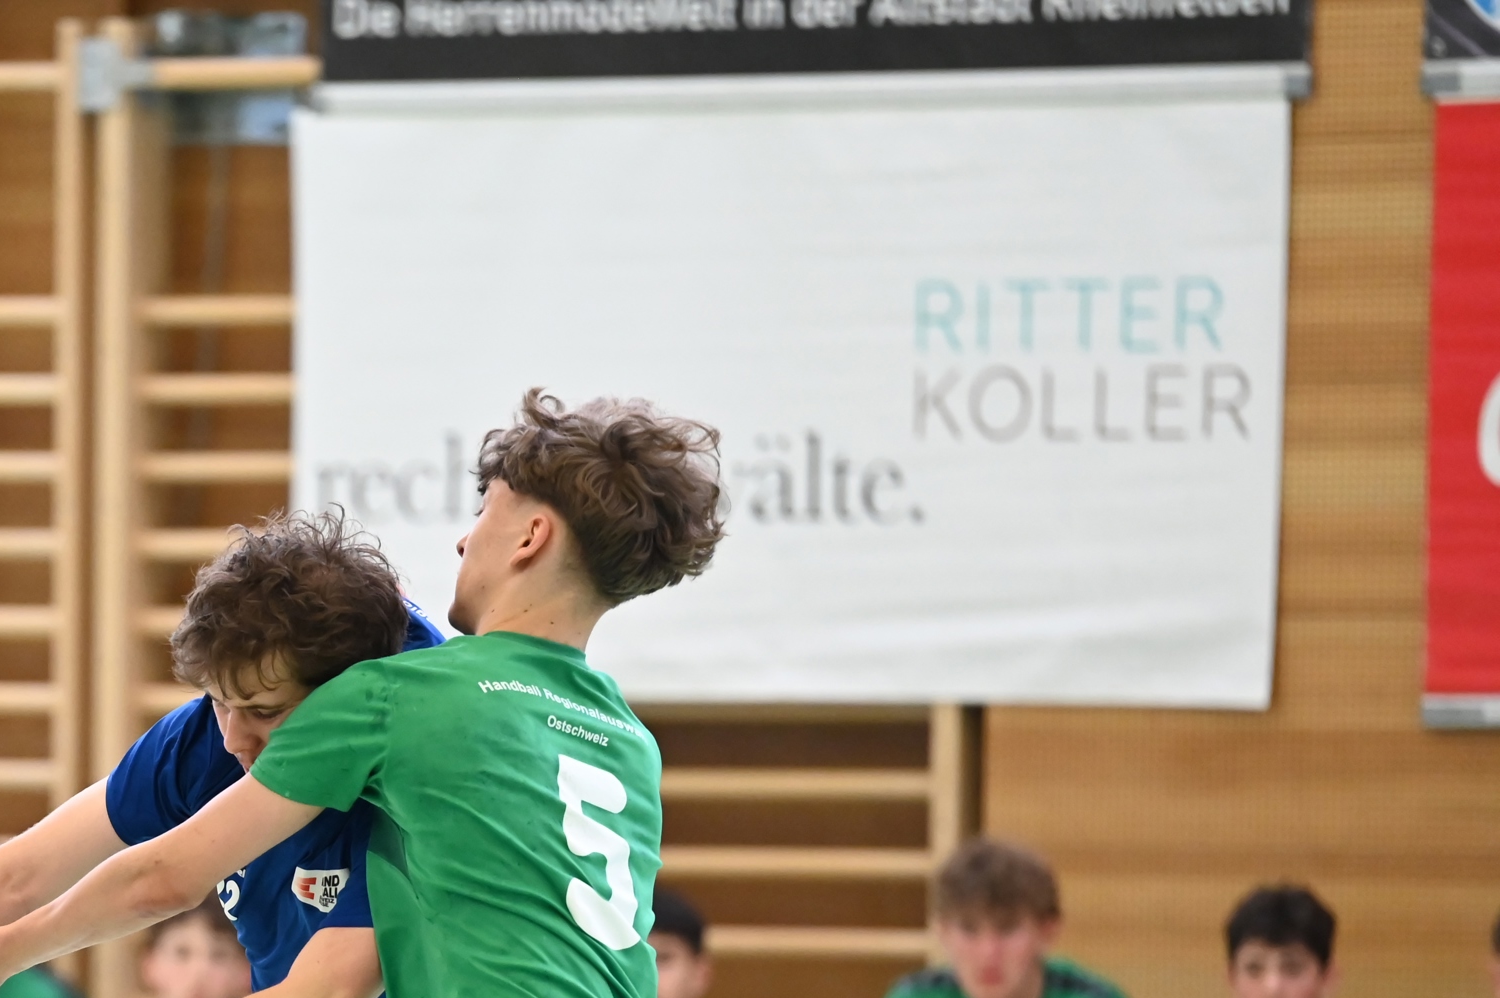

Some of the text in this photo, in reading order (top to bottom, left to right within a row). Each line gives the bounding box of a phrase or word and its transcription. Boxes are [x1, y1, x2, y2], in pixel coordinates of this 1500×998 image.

[332, 0, 399, 38] Die
[743, 0, 786, 30] in
[914, 275, 1226, 354] RITTER
[914, 363, 1254, 444] KOLLER
[478, 680, 542, 697] Handball
[547, 715, 609, 746] Ostschweiz
[557, 754, 641, 950] 5
